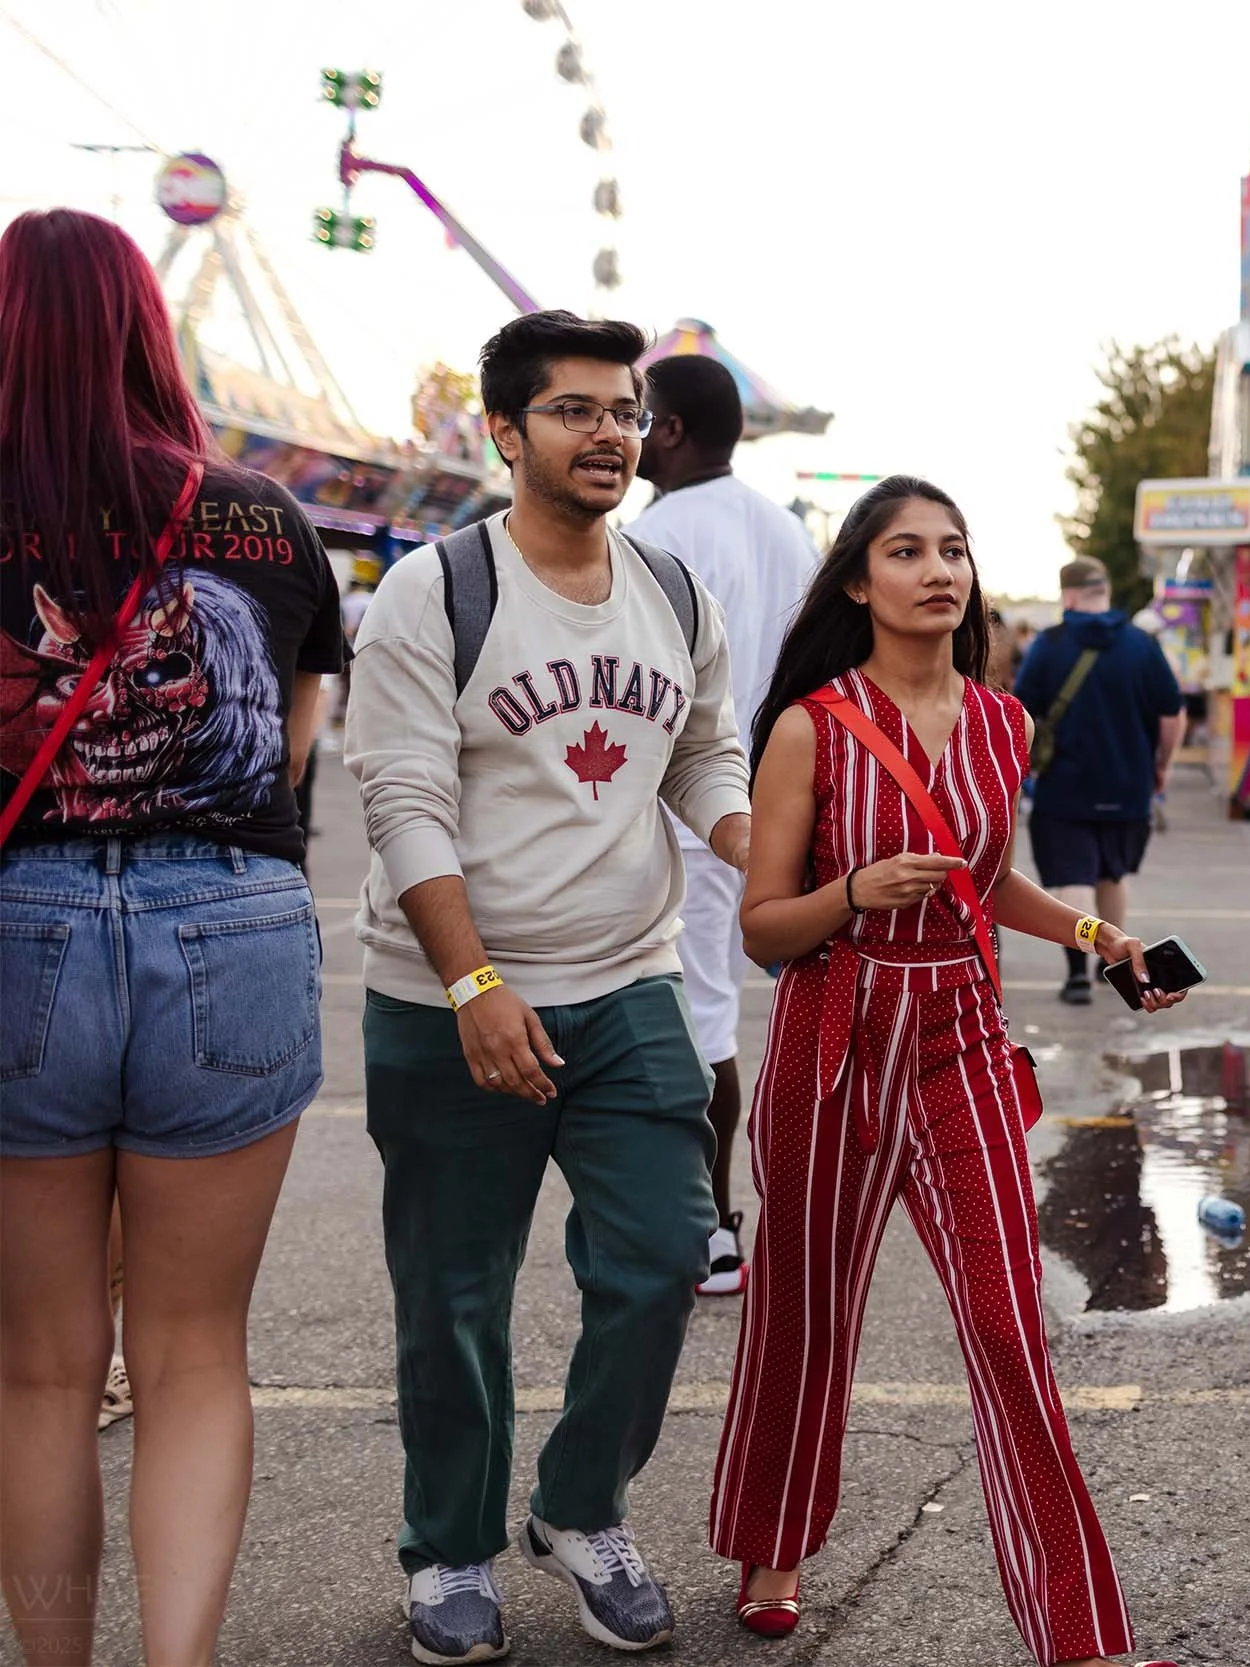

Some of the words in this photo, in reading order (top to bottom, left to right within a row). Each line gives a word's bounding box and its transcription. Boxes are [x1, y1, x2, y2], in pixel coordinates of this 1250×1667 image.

[105, 532, 215, 561] TUR
[224, 532, 293, 565] 2019
[488, 658, 582, 736] OLD
[589, 654, 687, 736] NAVY
